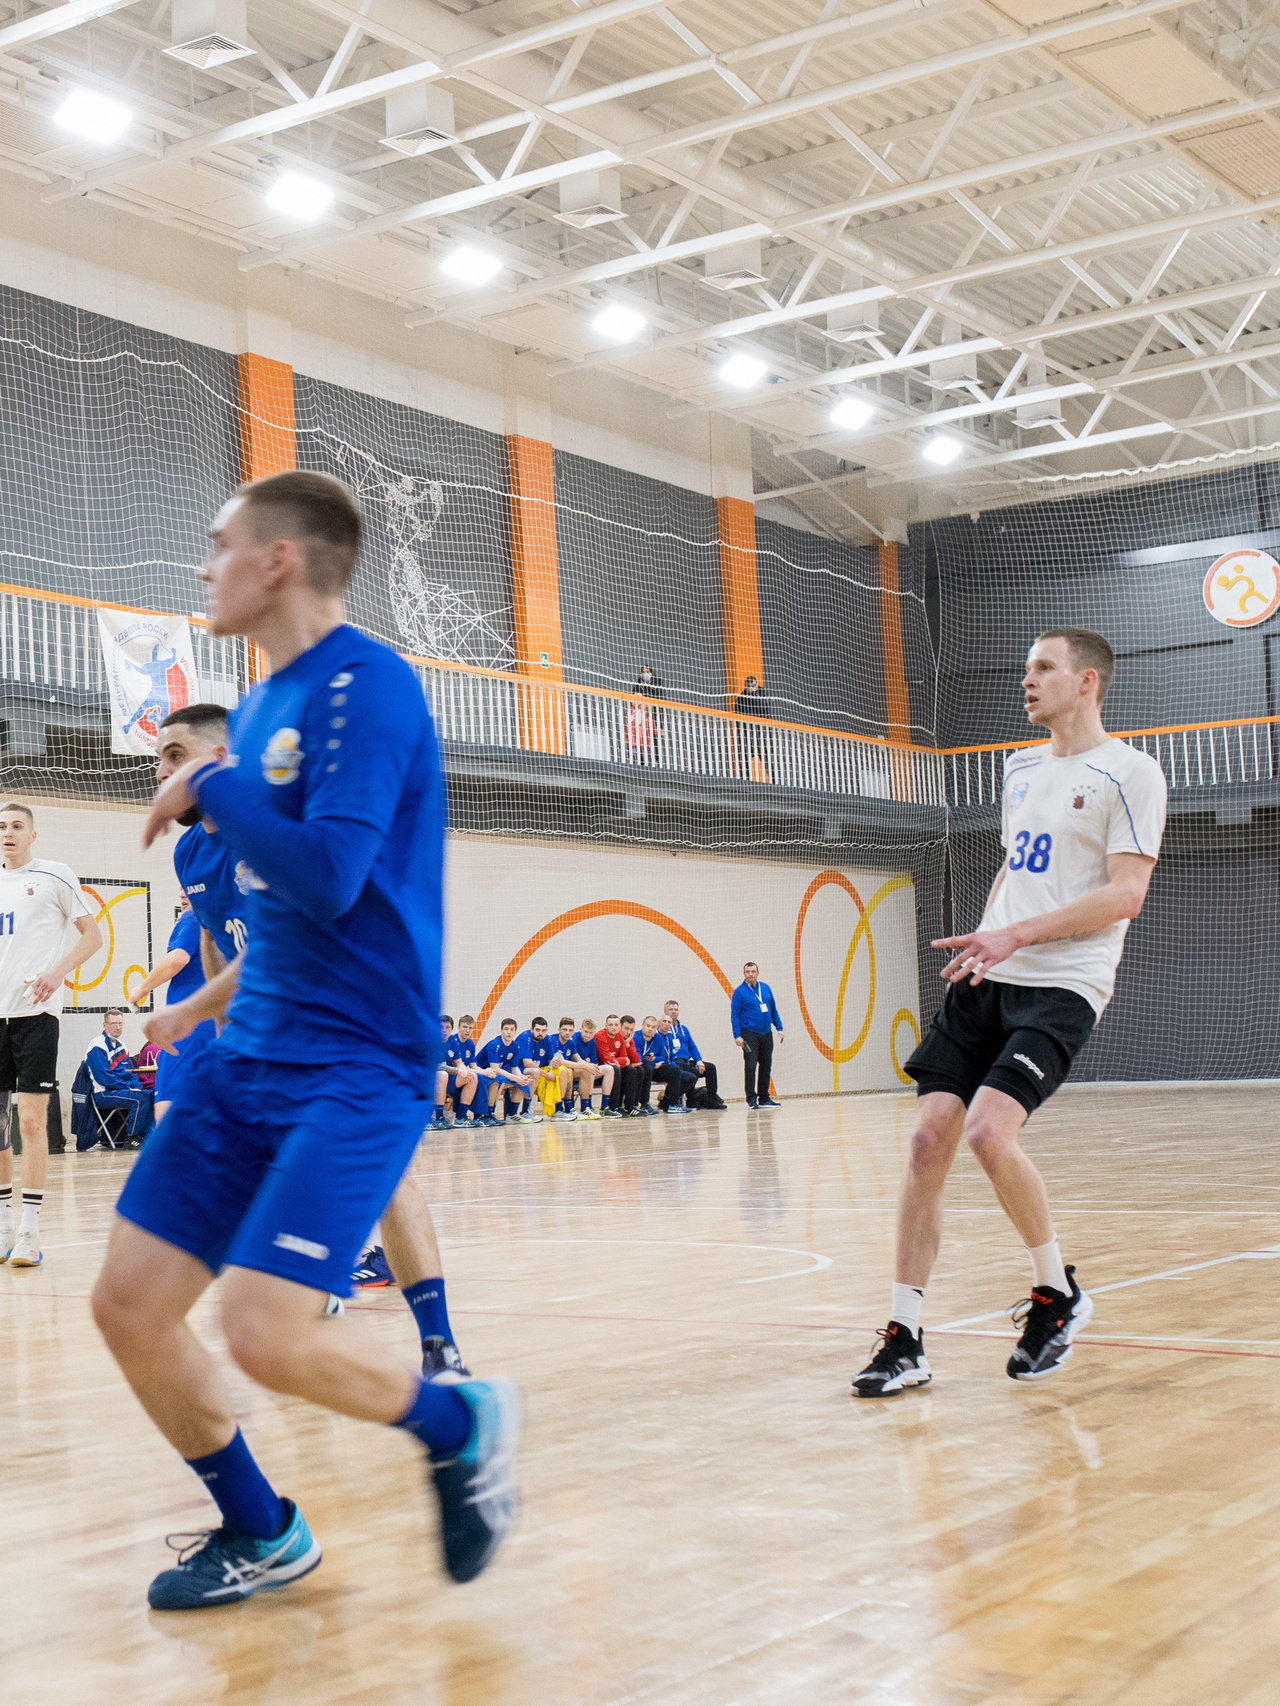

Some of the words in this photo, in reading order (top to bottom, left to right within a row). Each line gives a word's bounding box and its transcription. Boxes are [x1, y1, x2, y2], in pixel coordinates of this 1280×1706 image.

[134, 728, 156, 748] HANDB
[1009, 830, 1052, 873] 38
[186, 883, 206, 895] JAKO
